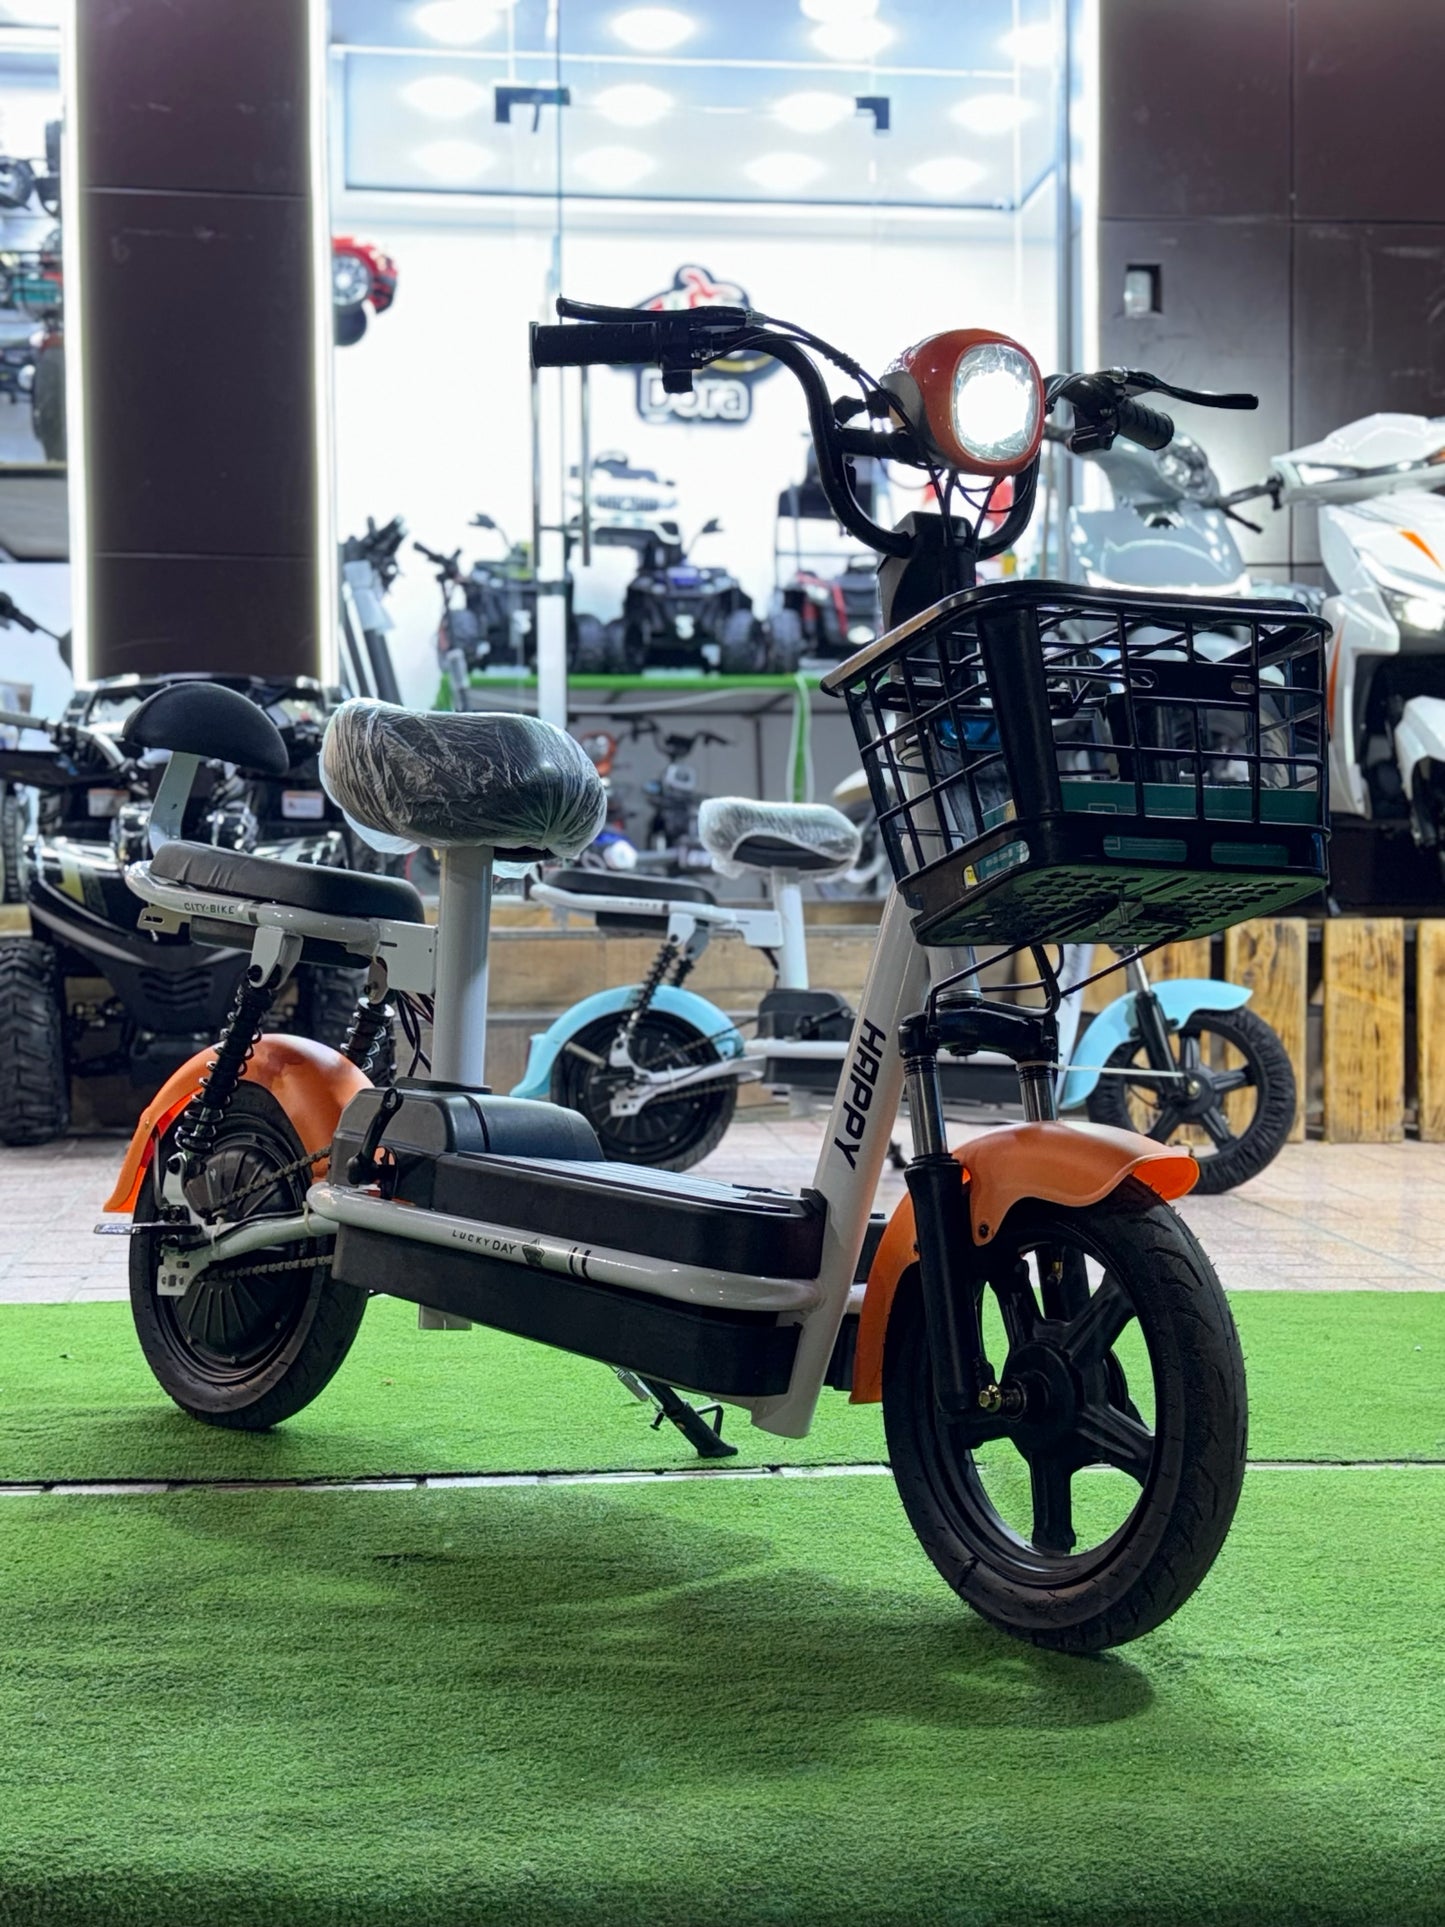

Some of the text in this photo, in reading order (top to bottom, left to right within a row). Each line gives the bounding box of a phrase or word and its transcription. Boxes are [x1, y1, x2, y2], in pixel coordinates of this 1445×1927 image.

[834, 1018, 886, 1170] HAPPY
[452, 1229, 517, 1255] LUCKY DAY
